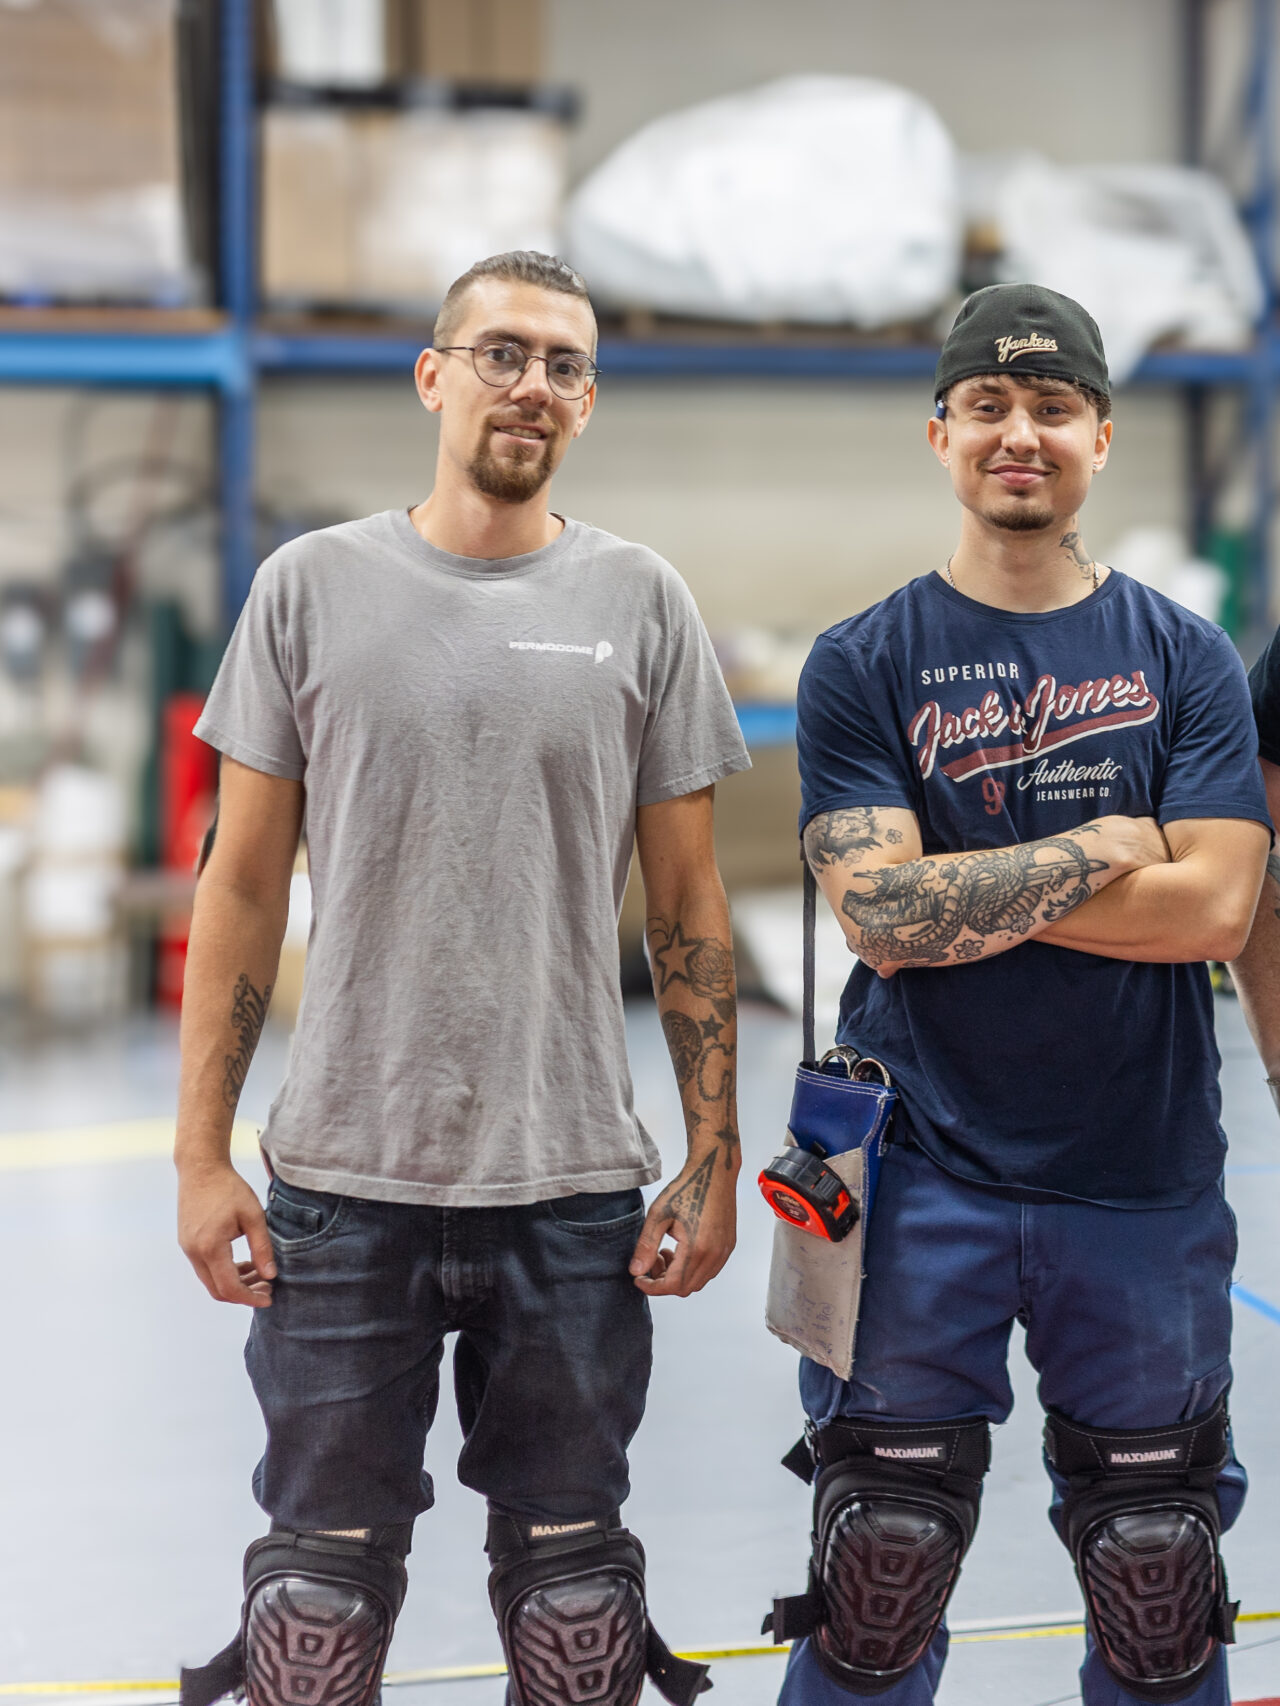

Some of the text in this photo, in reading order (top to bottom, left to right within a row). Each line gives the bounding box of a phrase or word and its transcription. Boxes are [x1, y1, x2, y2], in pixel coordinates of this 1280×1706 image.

[994, 332, 1058, 364] Yankees
[508, 641, 594, 655] PERMODOME
[921, 662, 1020, 686] SUPERIOR
[907, 690, 1010, 780] Jack
[1022, 670, 1154, 754] Jones
[1017, 757, 1124, 791] Authentic
[1036, 787, 1095, 802] JEANSWEAR
[873, 1446, 943, 1459] MAXIMUM
[1110, 1448, 1180, 1463] MAXIMUM
